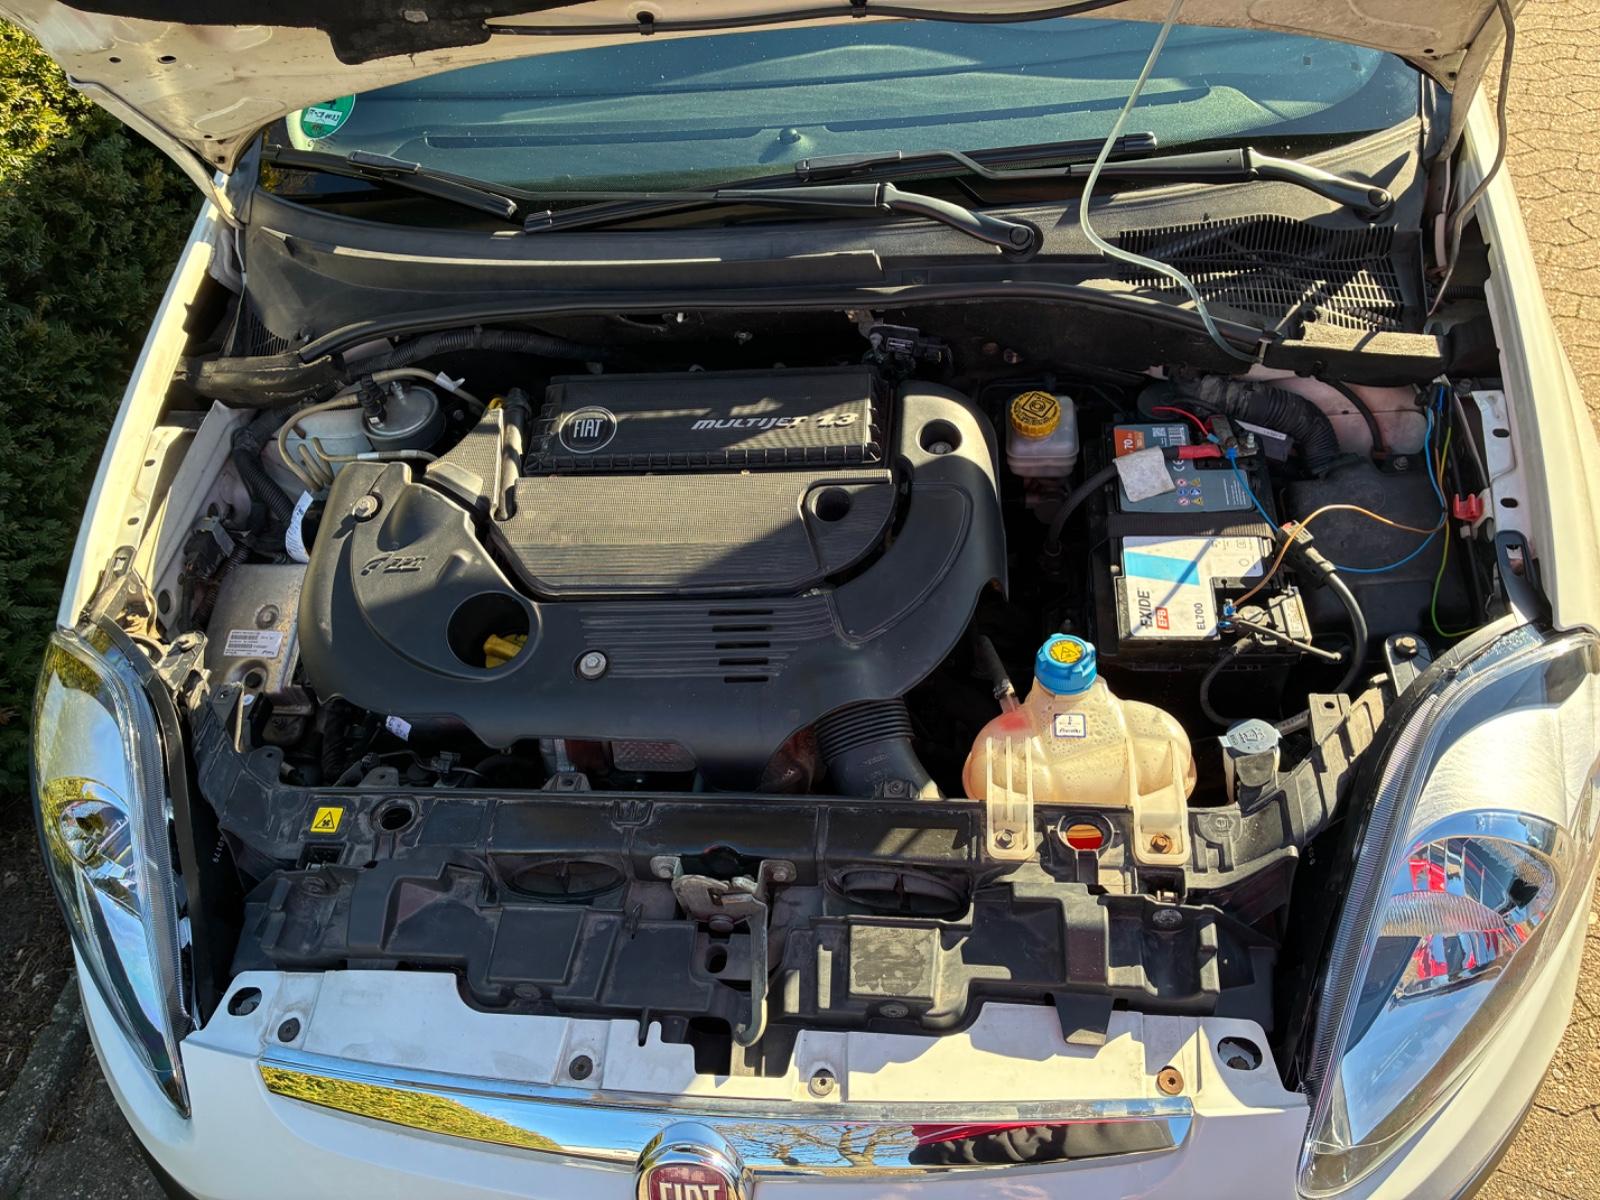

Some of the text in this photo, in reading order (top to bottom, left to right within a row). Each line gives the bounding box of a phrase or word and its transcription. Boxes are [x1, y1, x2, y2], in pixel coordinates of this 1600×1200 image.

[573, 419, 603, 438] FIAT
[691, 416, 808, 430] MULTIJET
[1137, 590, 1153, 629] EXIDE
[1157, 609, 1167, 627] EFB
[1194, 602, 1205, 630] EL700
